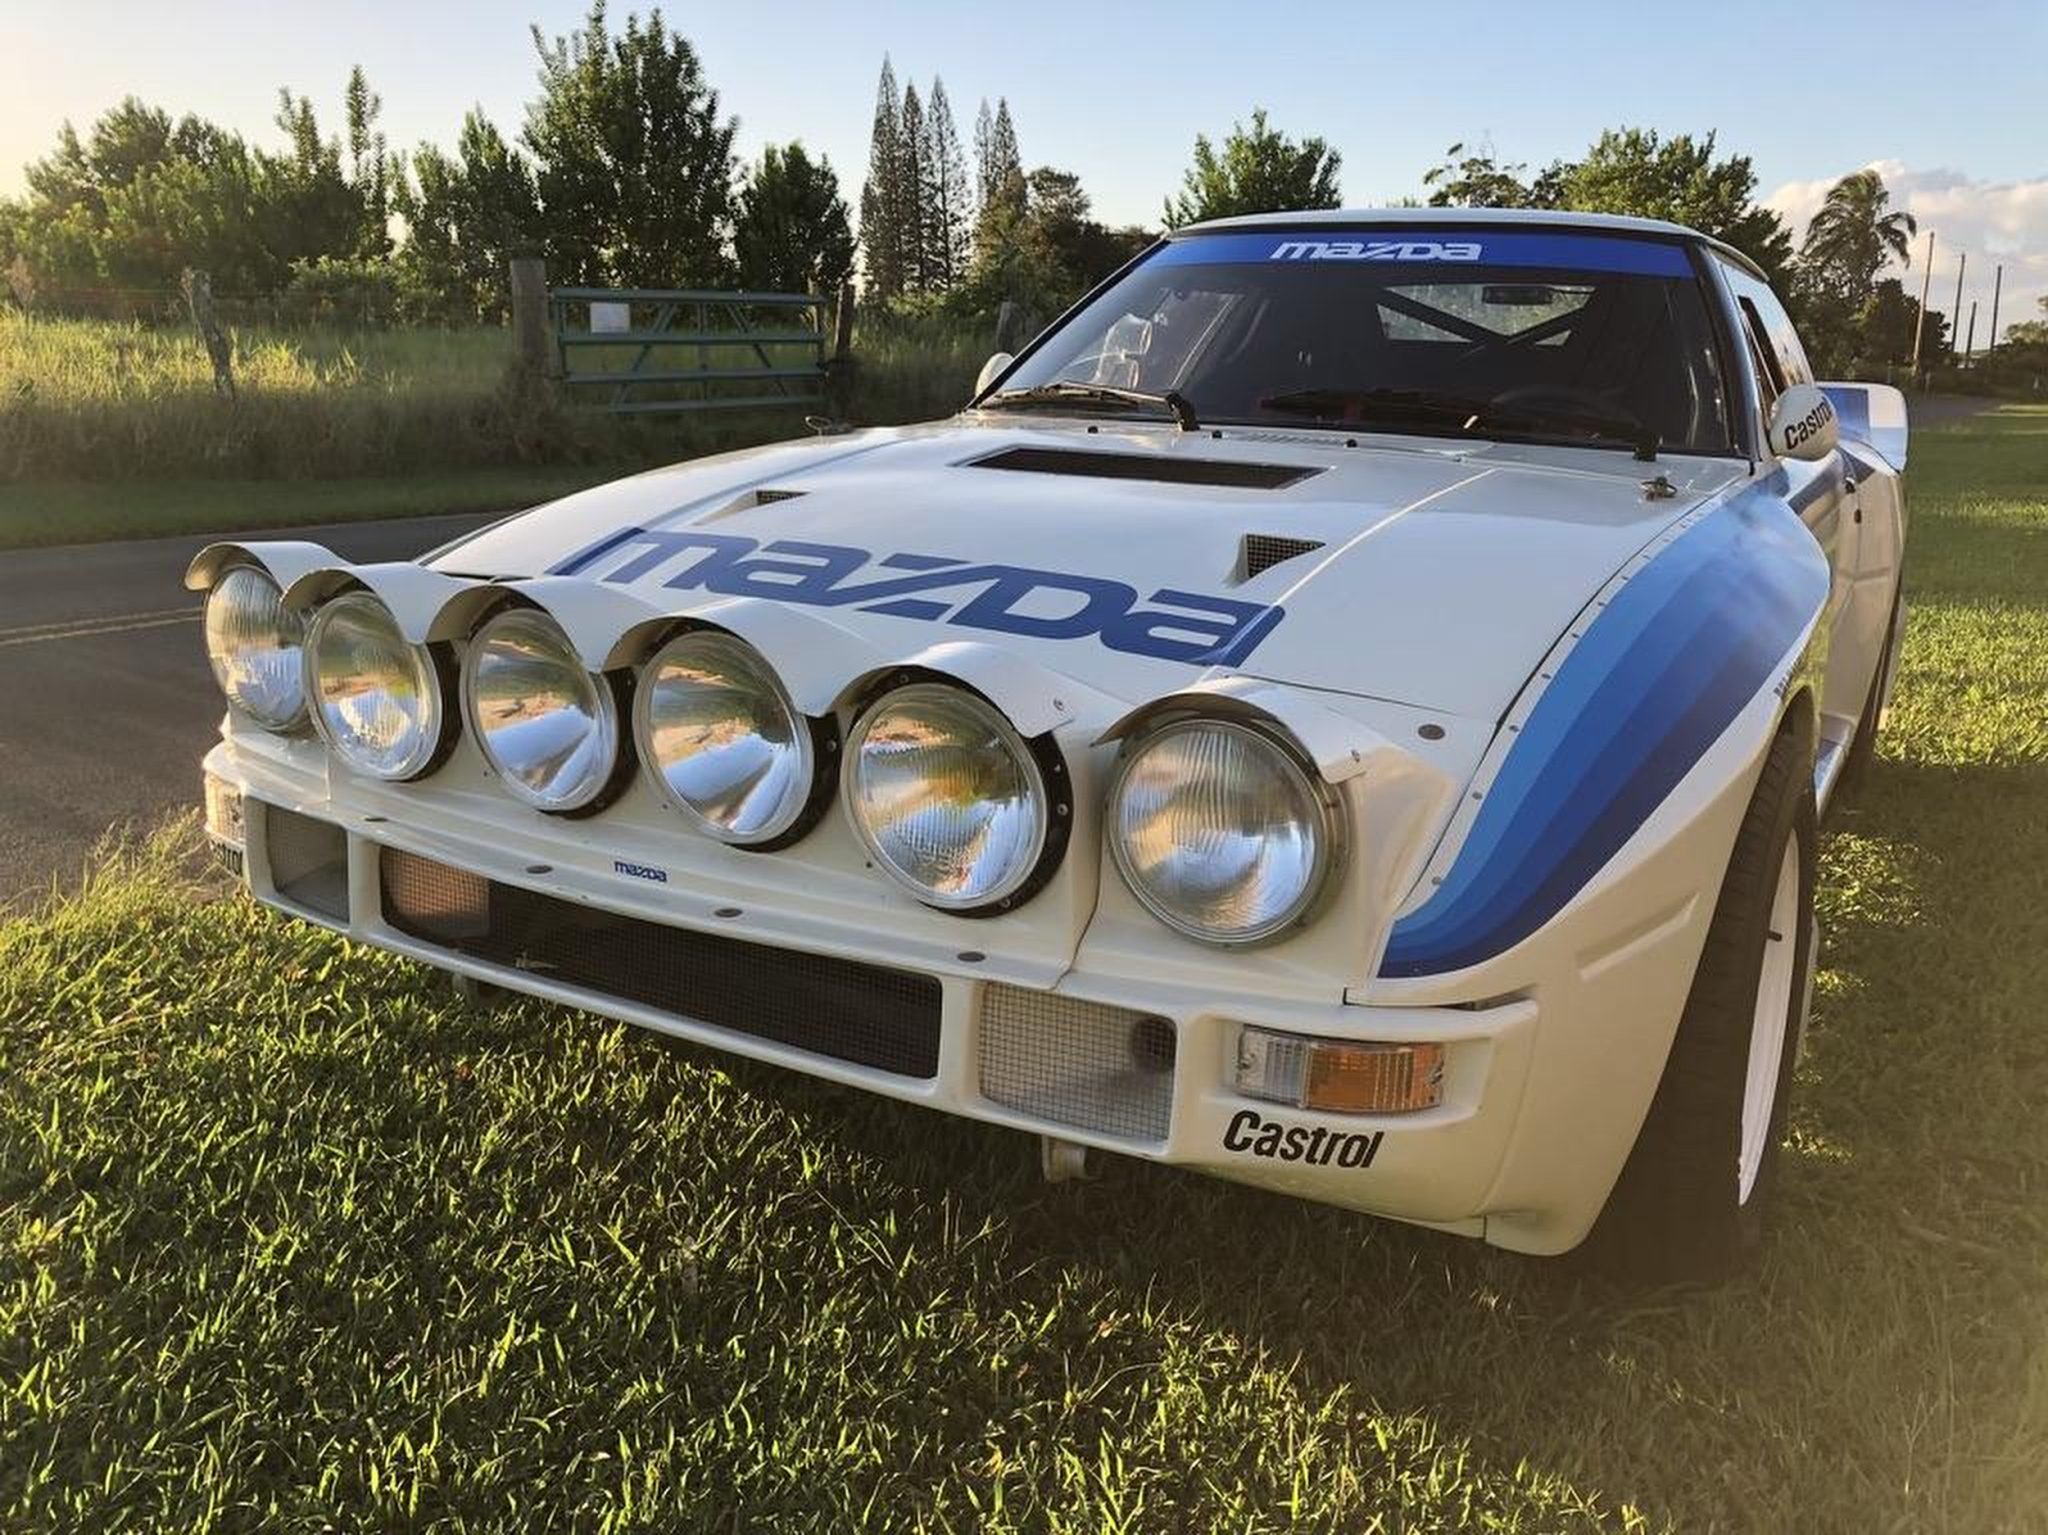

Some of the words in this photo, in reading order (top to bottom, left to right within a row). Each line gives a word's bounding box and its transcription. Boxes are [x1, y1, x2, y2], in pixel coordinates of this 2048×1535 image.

[1269, 242, 1482, 260] mazda
[545, 527, 1285, 668] mazda
[614, 861, 667, 882] mazda
[1223, 1110, 1384, 1168] Castrol
